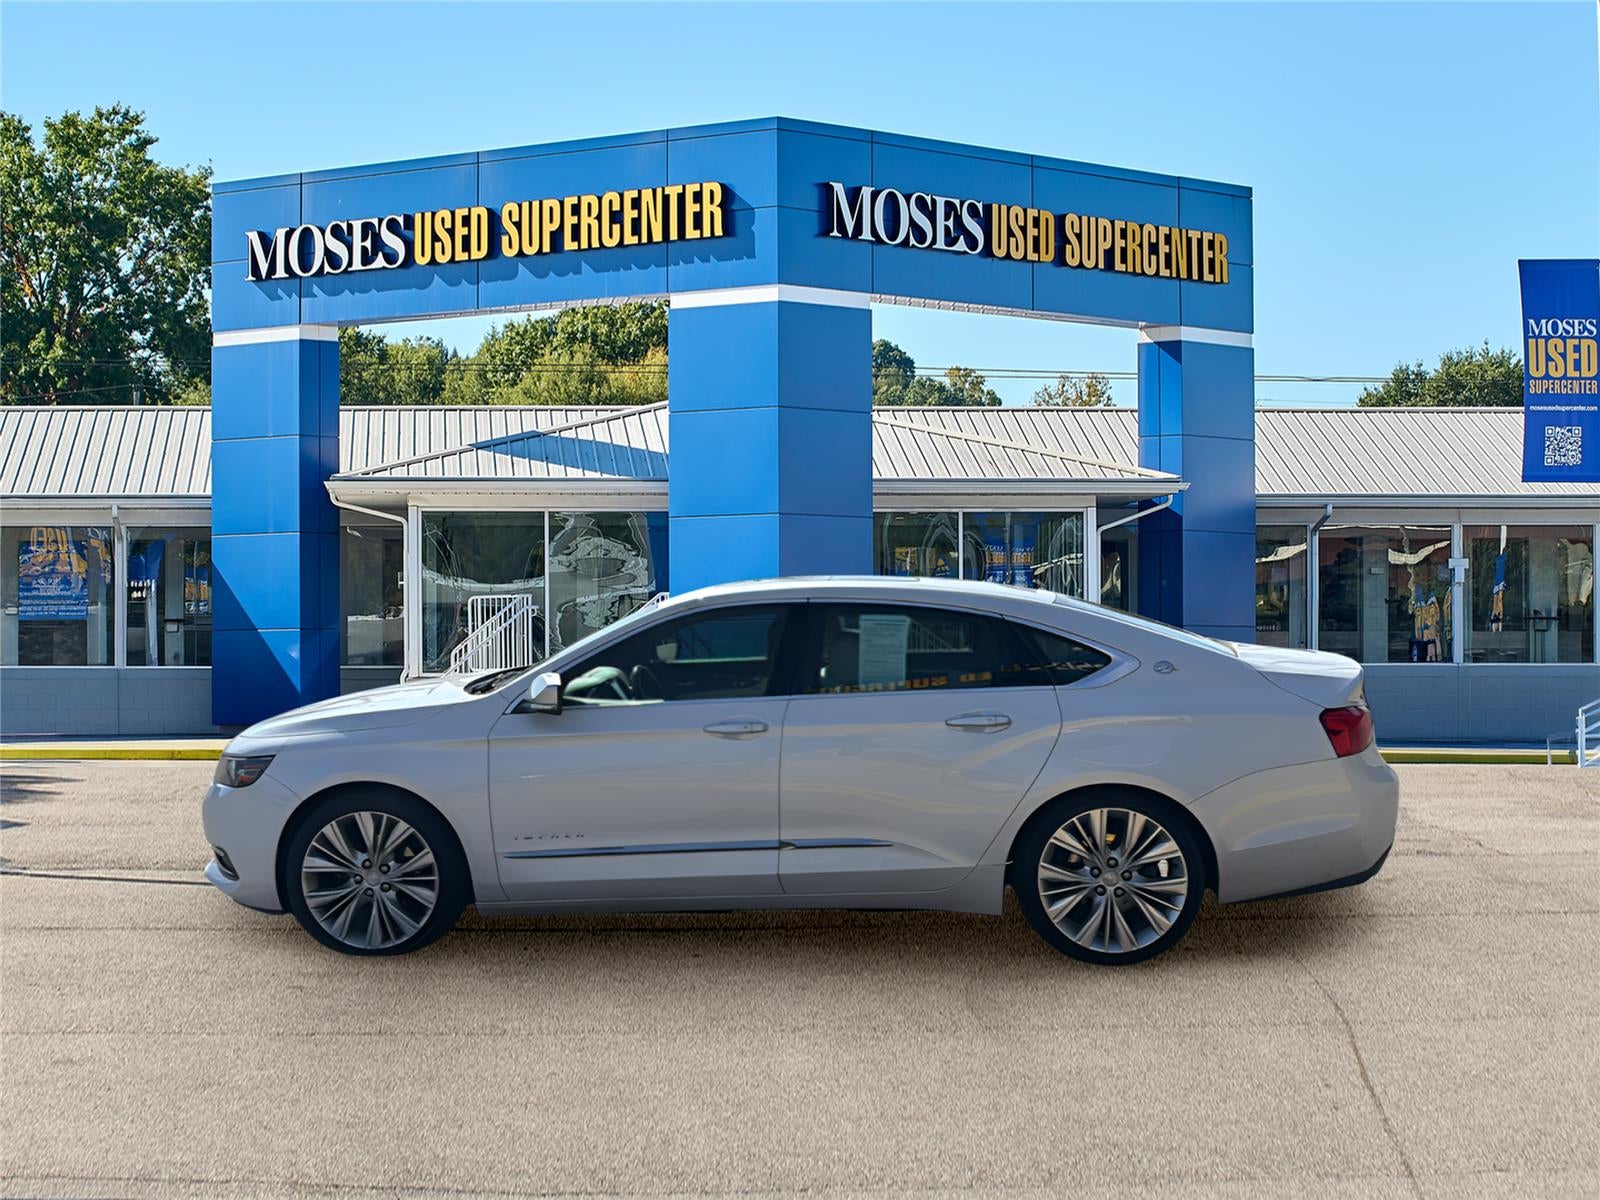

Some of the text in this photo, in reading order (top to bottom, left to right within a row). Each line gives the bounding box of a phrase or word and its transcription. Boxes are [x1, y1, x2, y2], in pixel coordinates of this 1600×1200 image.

[244, 181, 724, 281] MOSES USED SUPERCENTER
[829, 182, 1230, 284] MOSES USED SUPERCENTER
[1527, 318, 1598, 337] MOSES
[1528, 338, 1598, 378] USED
[1529, 379, 1598, 394] SUPERCENTER
